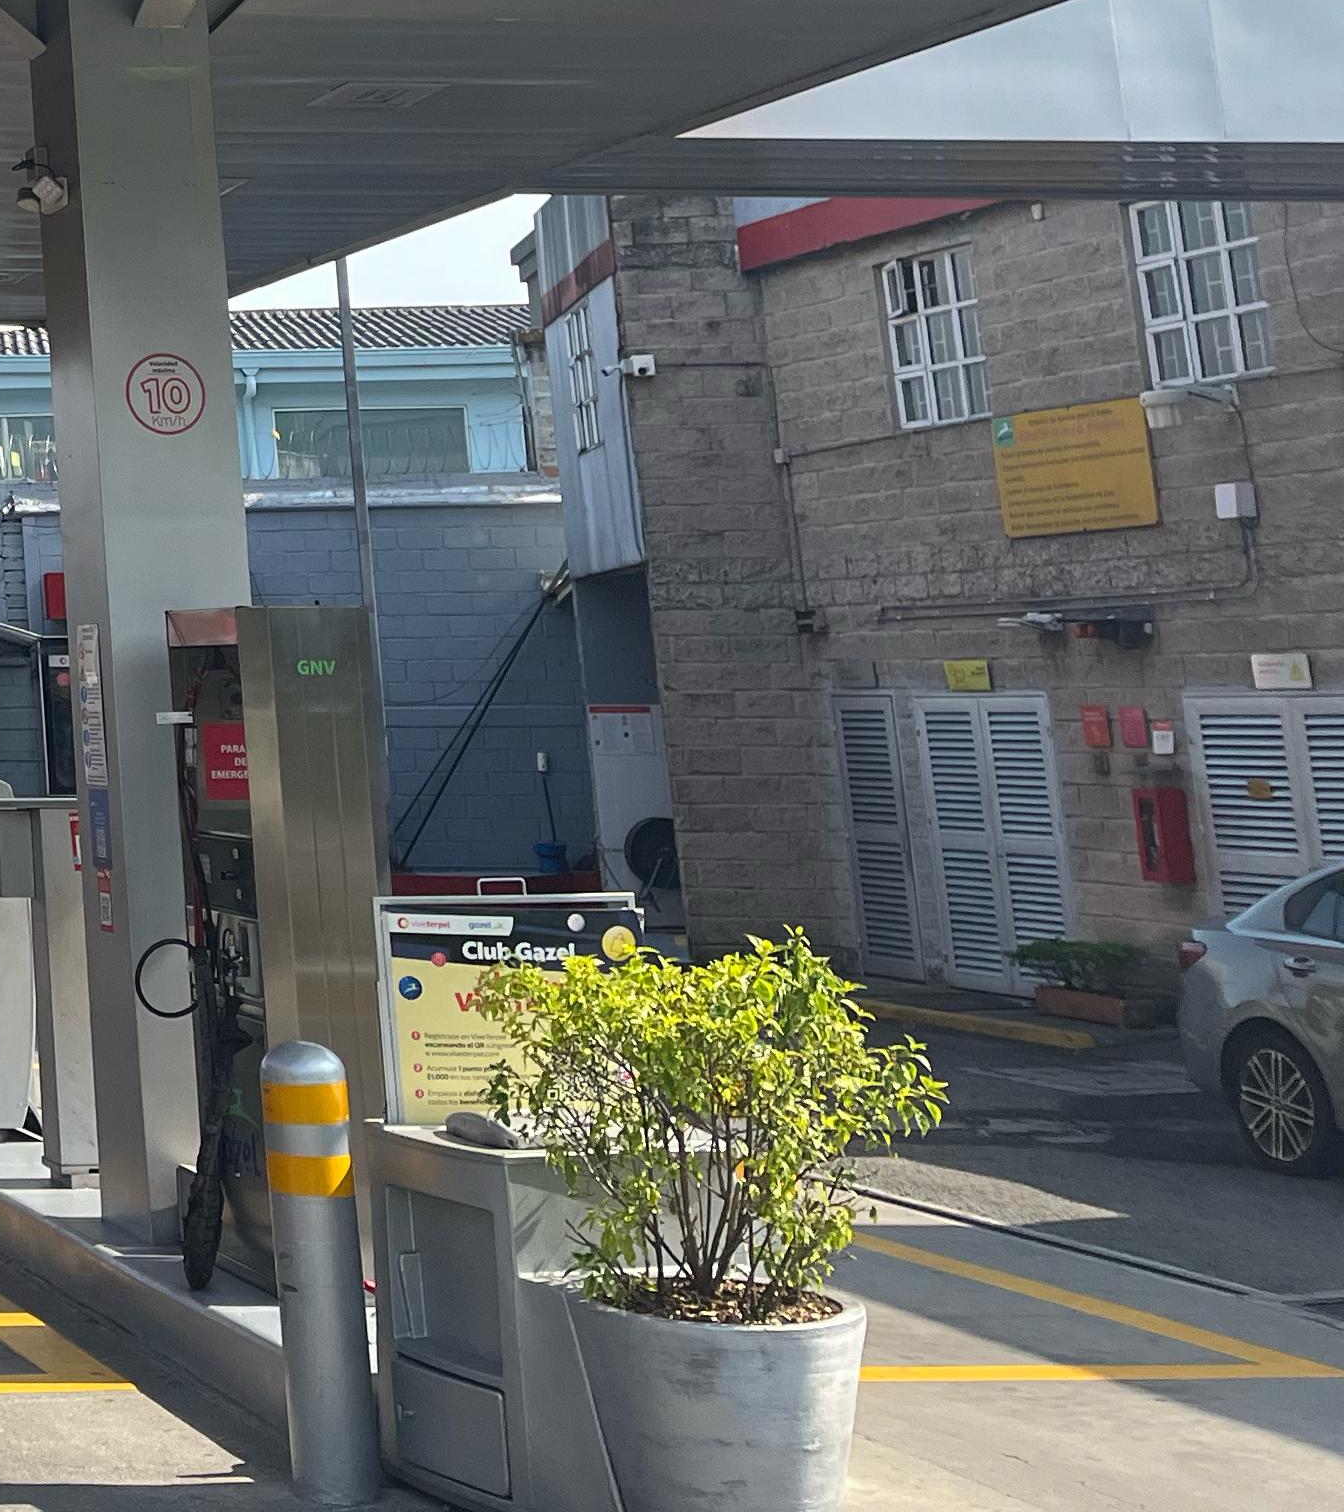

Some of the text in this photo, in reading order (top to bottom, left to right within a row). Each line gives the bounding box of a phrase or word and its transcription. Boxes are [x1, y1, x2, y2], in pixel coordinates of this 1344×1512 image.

[140, 377, 191, 414] 10
[152, 415, 186, 427] Km/h
[296, 659, 336, 676] GNV
[468, 920, 492, 930] gazel
[461, 940, 577, 963] Club Gazel
